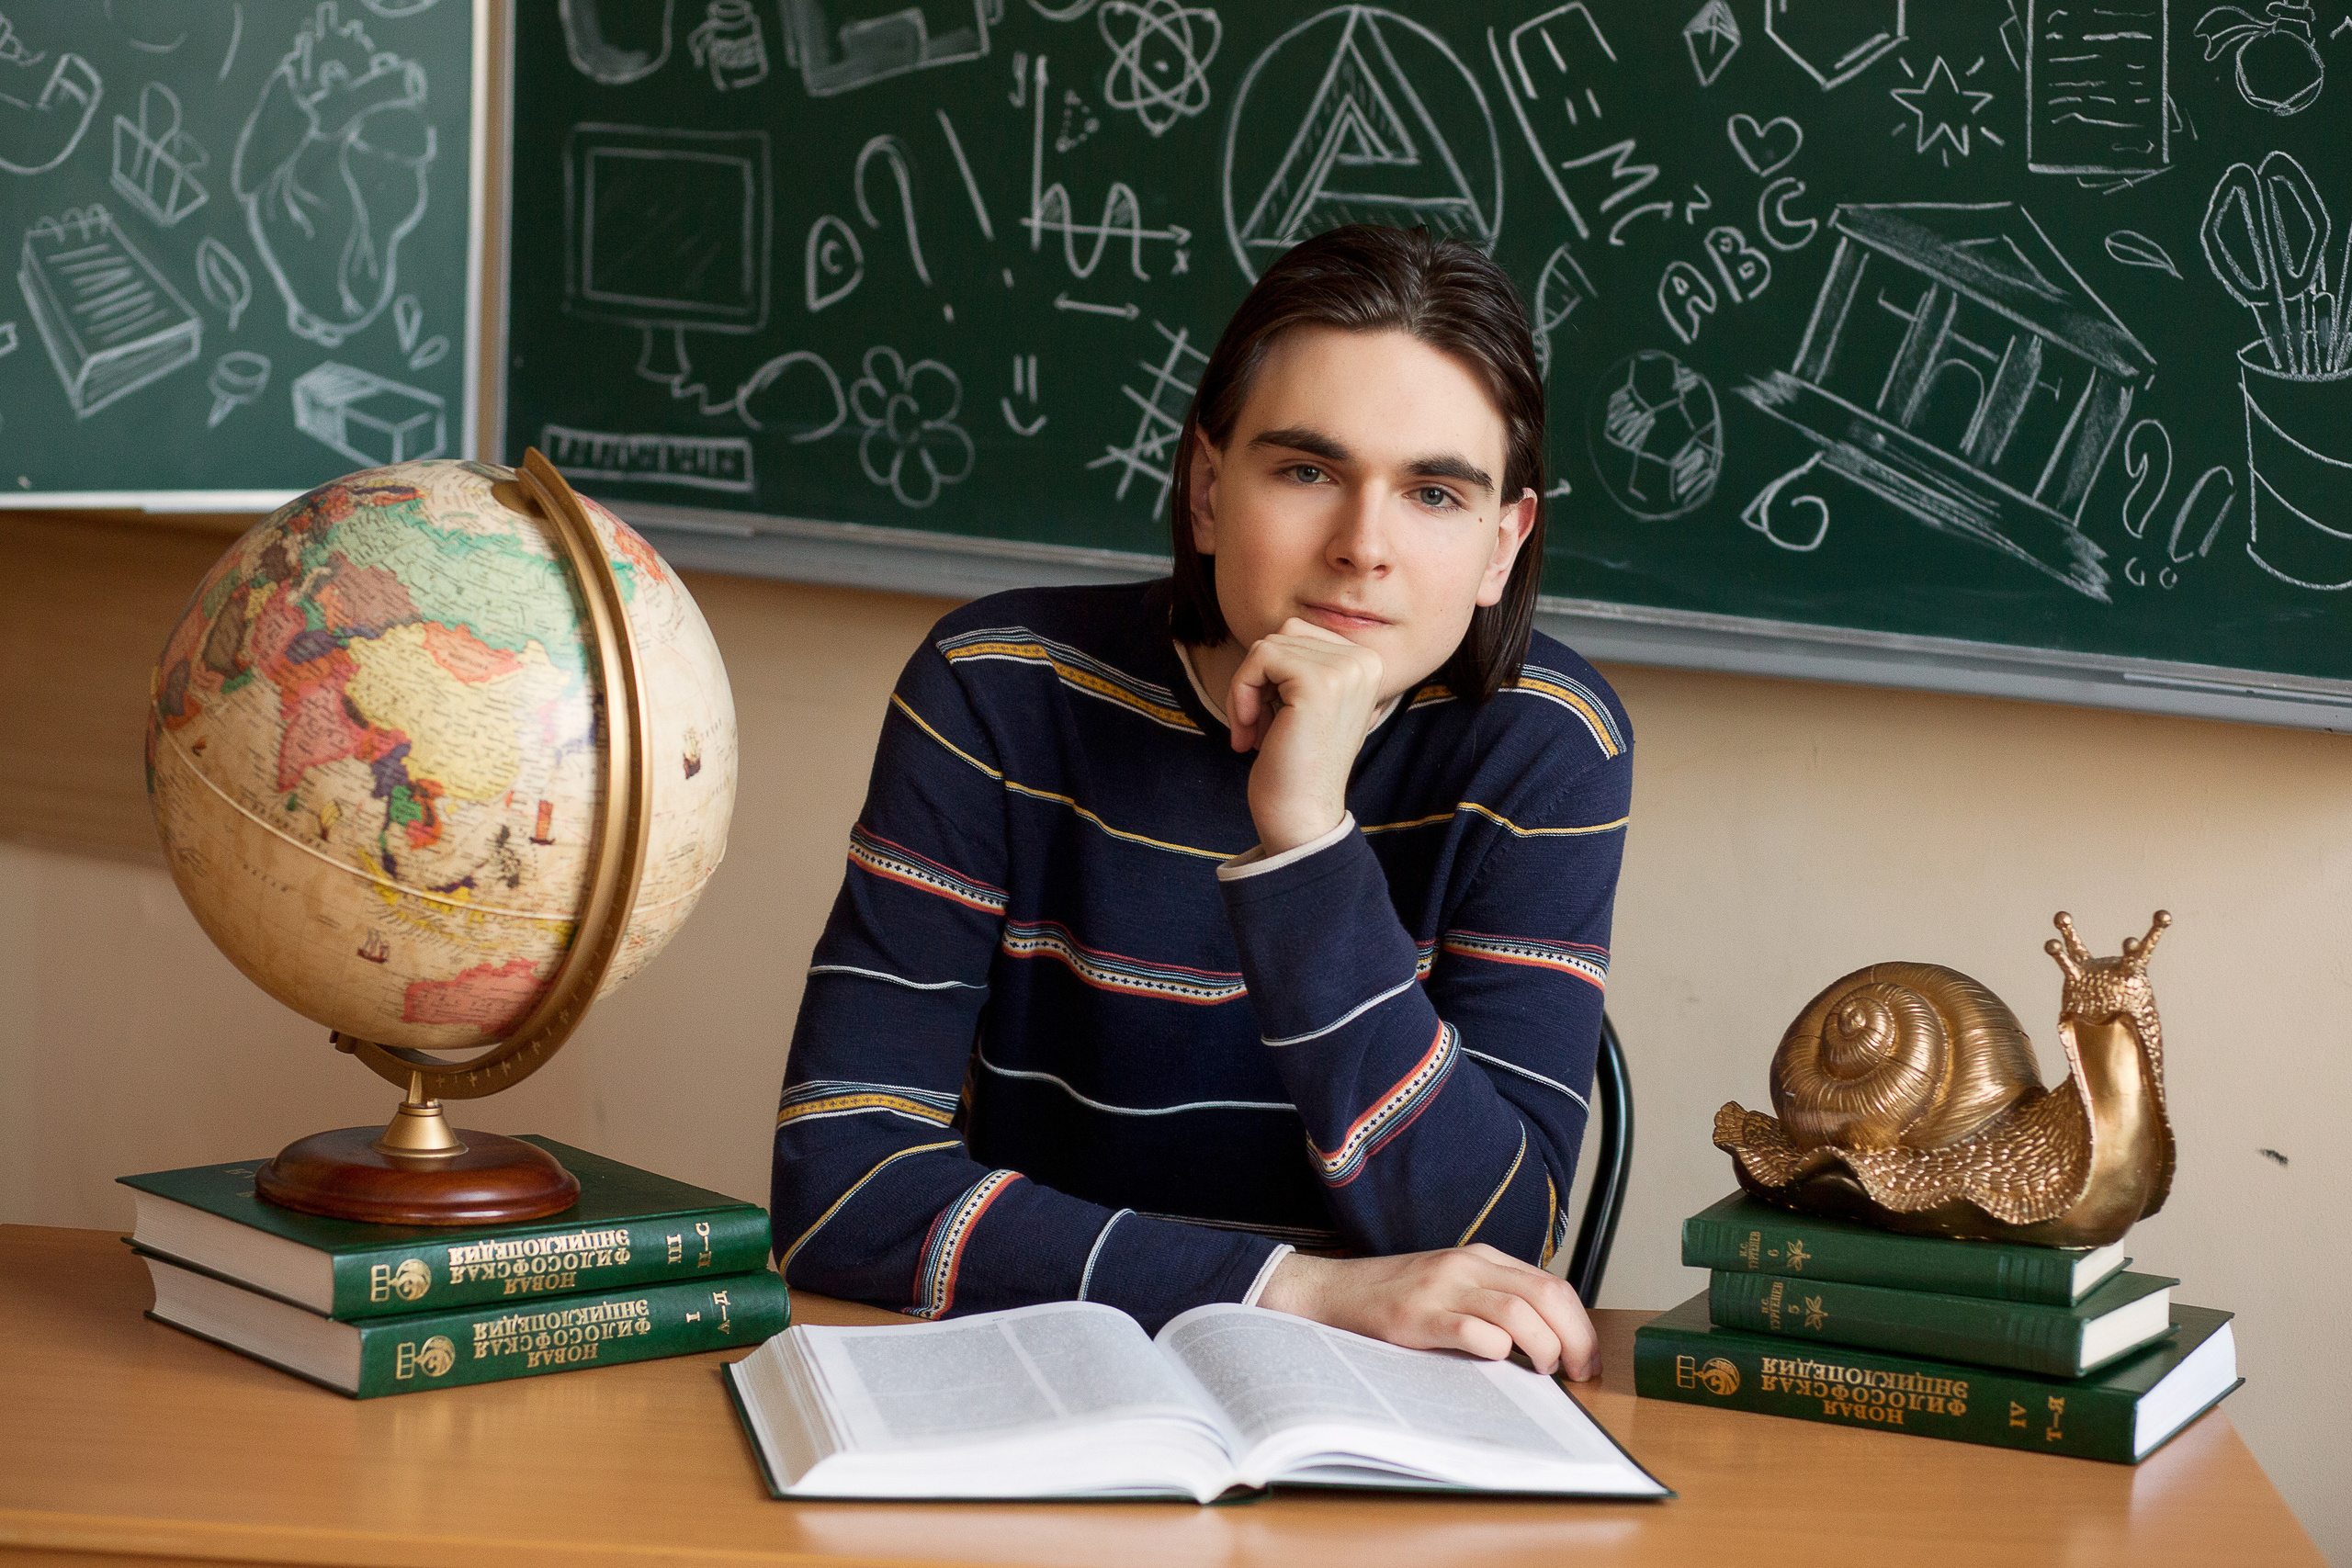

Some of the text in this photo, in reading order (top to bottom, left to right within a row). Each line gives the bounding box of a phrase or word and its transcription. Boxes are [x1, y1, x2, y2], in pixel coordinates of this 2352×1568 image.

[447, 1228, 631, 1268] ЭНЦИКЛОПЕДИЯ
[449, 1247, 632, 1285] ФИЛОСОФСКАЯ
[666, 1233, 683, 1265] III
[1747, 1230, 1761, 1269] ТУРГЕНЕВ
[1767, 1248, 1780, 1258] 6
[503, 1271, 577, 1295] НОВАЯ
[472, 1298, 651, 1341] ЭНЦИКЛОПЕДИЯ
[1770, 1280, 1784, 1330] ТУРГЕНЕВ
[1787, 1304, 1801, 1314] 5
[472, 1320, 652, 1359] ФИЛОСОФСКАЯ
[526, 1343, 598, 1368] НОВАЯ
[1759, 1375, 1968, 1417] ФИЛОСОФСКАЯ
[1760, 1356, 1970, 1400] ЭНЦИКЛОПЕДИЯ
[1822, 1400, 1905, 1426] НОВАЯ
[2008, 1400, 2028, 1428] IV
